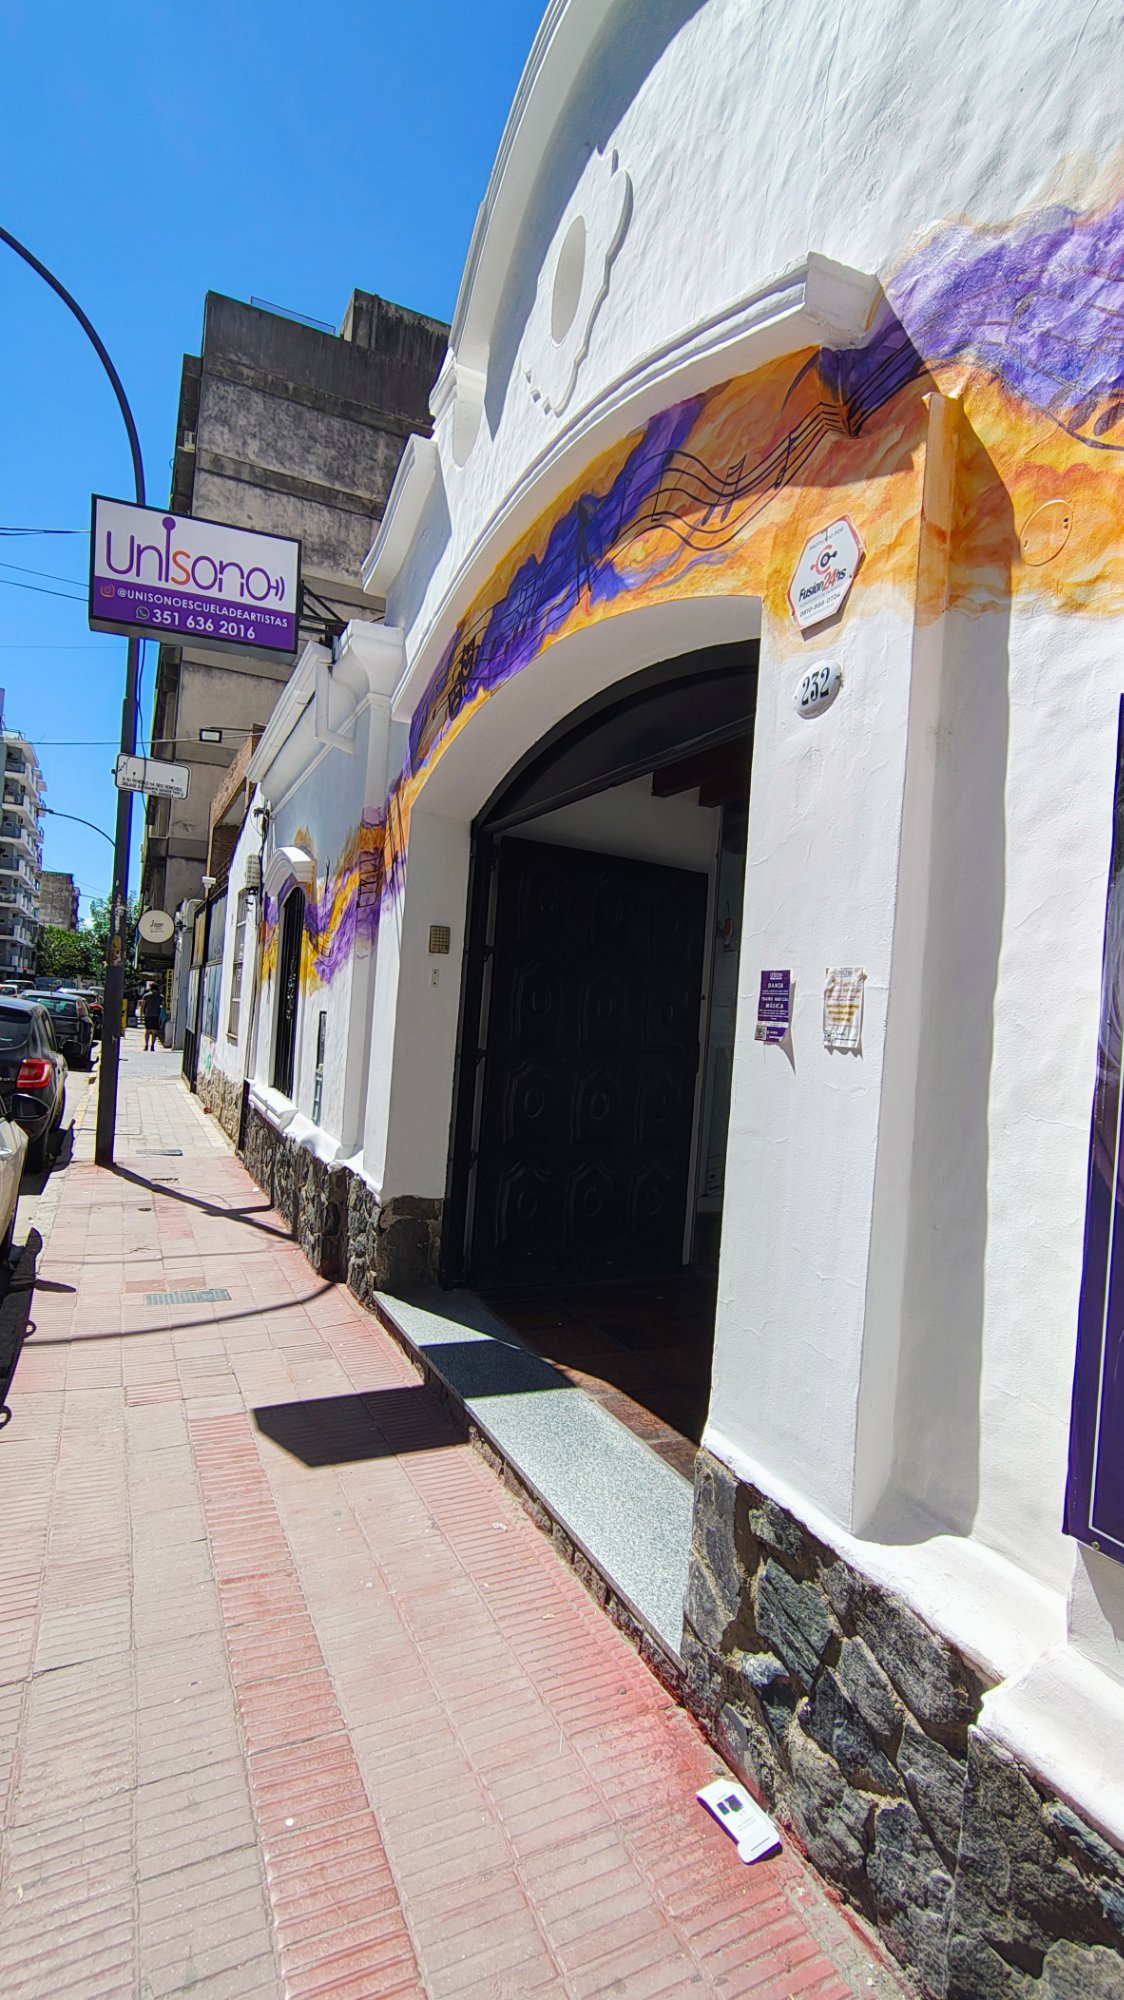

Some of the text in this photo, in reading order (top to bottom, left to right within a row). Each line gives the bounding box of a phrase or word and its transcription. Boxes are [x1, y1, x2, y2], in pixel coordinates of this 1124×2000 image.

[106, 517, 271, 601] Unisono
[117, 588, 288, 628] @UNISONOESCUELADEARTISTAS
[152, 609, 256, 639] 351 636 2016
[801, 666, 830, 706] 232
